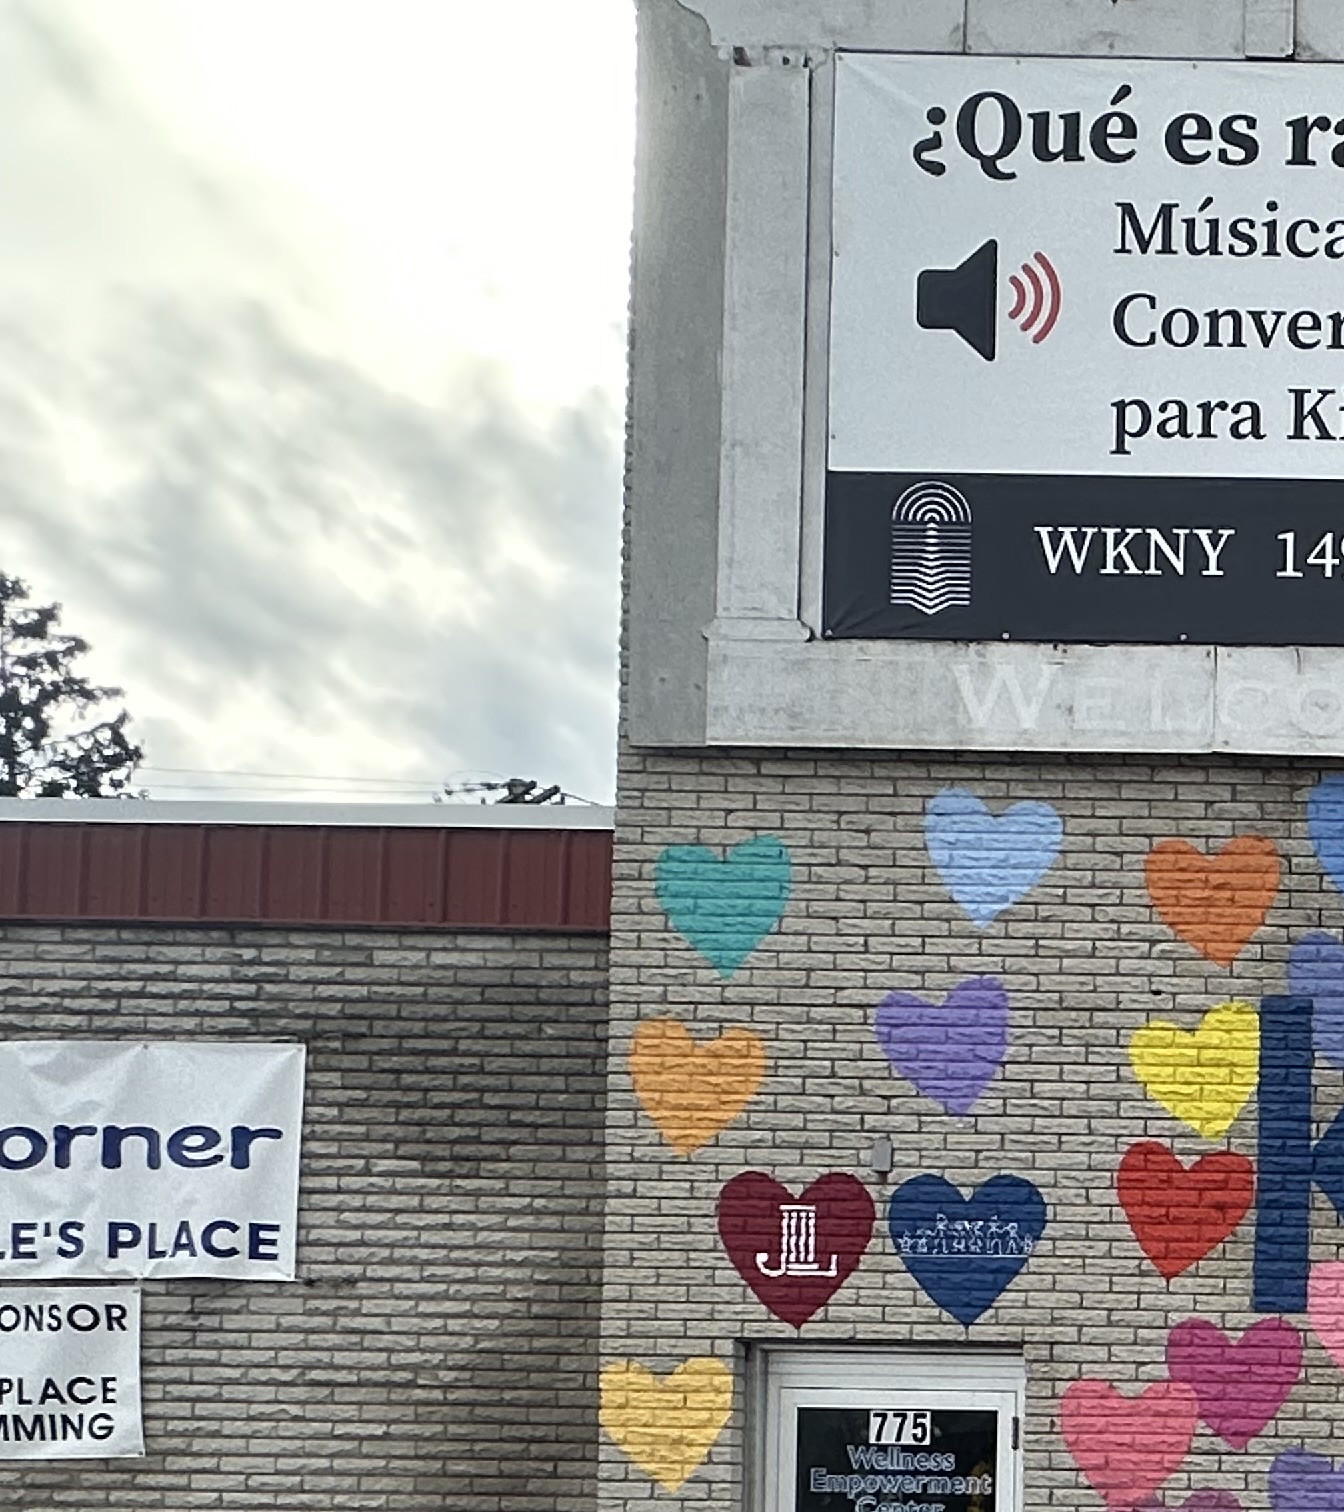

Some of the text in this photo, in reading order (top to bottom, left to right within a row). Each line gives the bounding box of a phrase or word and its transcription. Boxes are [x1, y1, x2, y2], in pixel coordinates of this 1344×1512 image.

[912, 84, 1139, 180] ¿Qué
[1163, 111, 1261, 167] es
[1109, 397, 1266, 455] para
[1033, 526, 1235, 577] WKNY
[0, 1219, 281, 1261] E'S PLACE
[0, 1376, 118, 1405] PLACE
[871, 1411, 929, 1443] 775
[847, 1445, 956, 1472] Wellness
[810, 1467, 993, 1499] Empowerment
